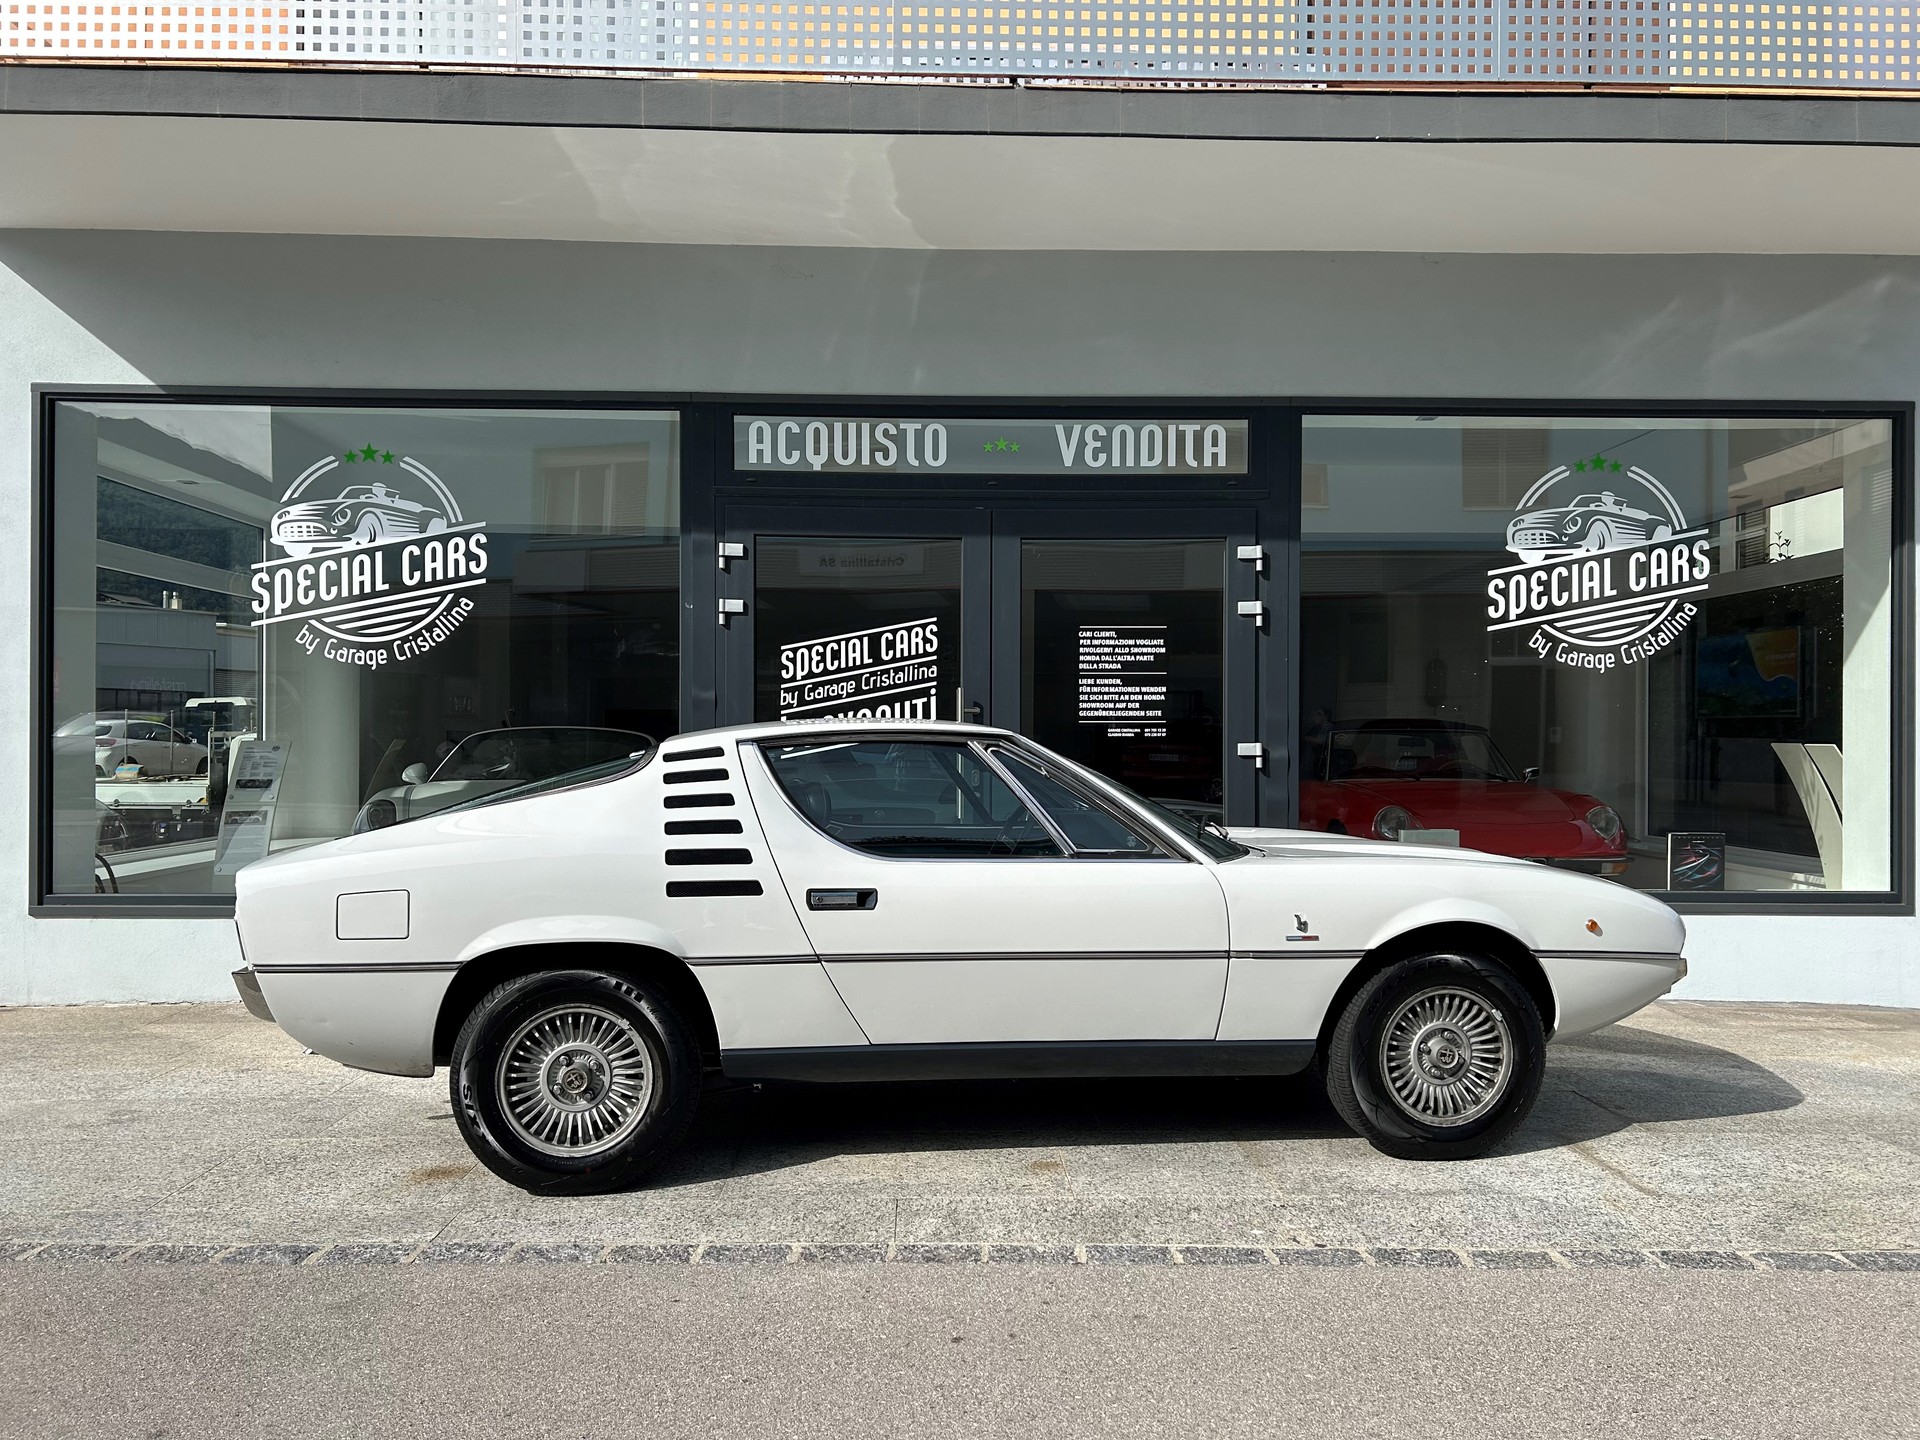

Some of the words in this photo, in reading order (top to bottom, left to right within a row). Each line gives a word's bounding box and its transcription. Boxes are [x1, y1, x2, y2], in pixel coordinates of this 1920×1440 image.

[747, 420, 948, 470] ACQUISTO
[1054, 424, 1227, 468] VENDITA
[251, 550, 390, 616] SPECIAL
[401, 532, 488, 587] CARS
[1487, 557, 1617, 621] SPECIAL
[1628, 539, 1710, 592] CARS
[295, 624, 320, 655] by
[323, 639, 388, 670] Garage
[393, 596, 475, 661] Cristallina
[781, 636, 873, 681] SPECIAL
[880, 624, 938, 661] CARS
[1528, 628, 1552, 659] by
[1555, 642, 1616, 674] Garage
[1620, 601, 1698, 665] Cristallina
[780, 690, 799, 708] by
[804, 680, 856, 698] Garage
[861, 664, 938, 690] Cristallina
